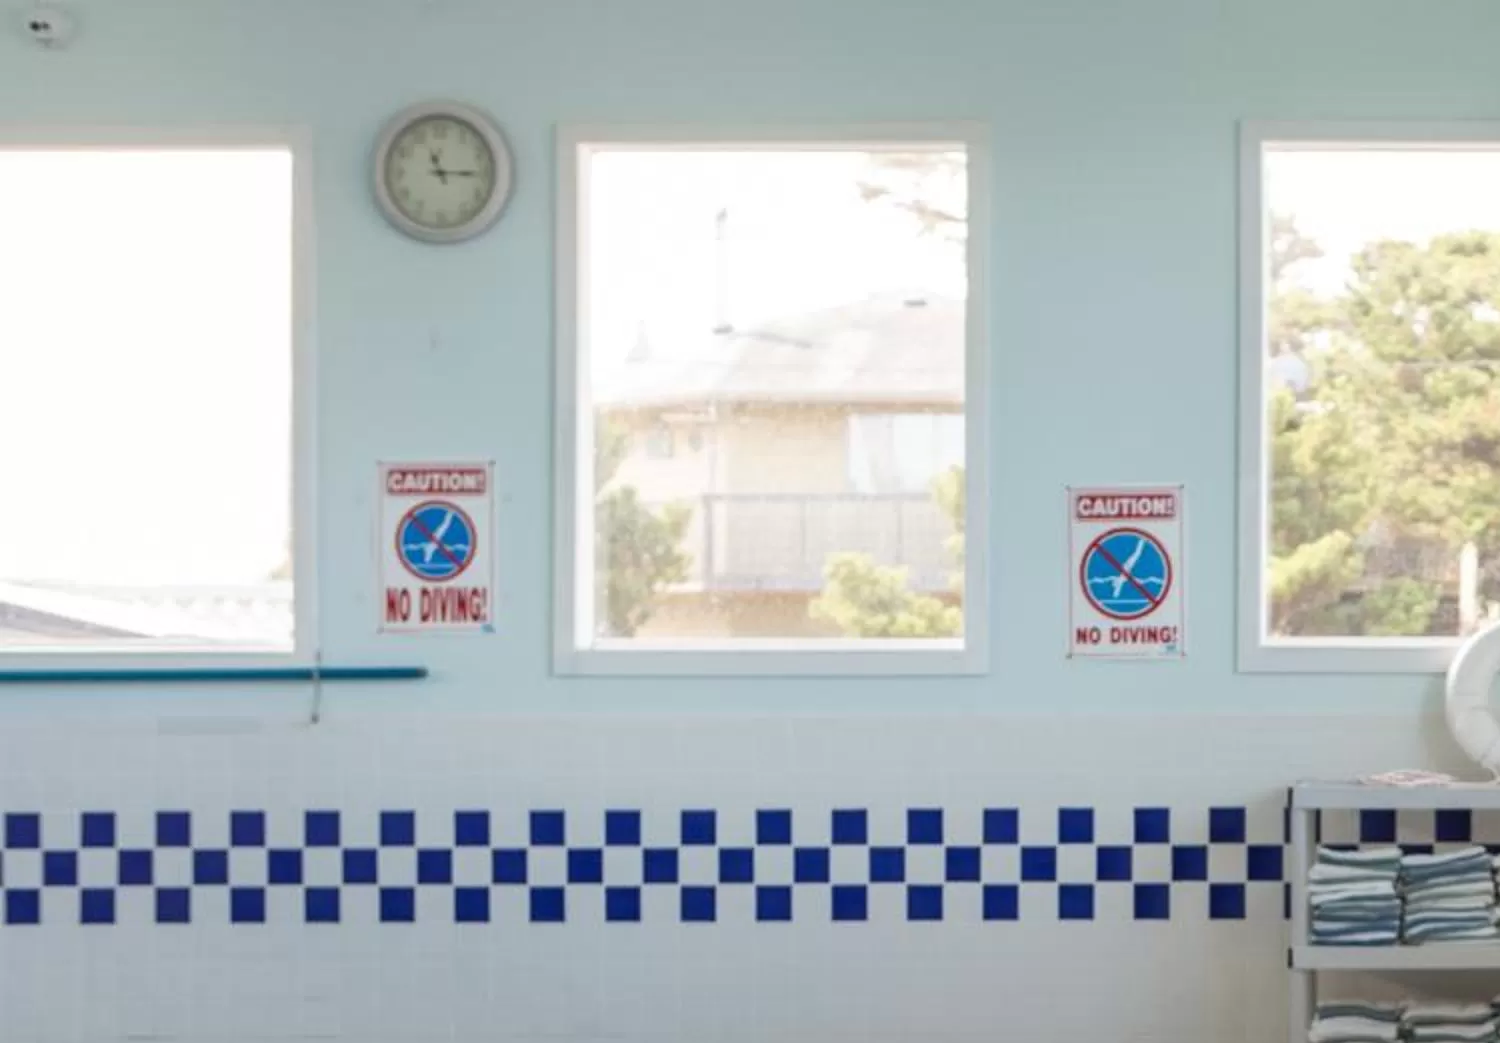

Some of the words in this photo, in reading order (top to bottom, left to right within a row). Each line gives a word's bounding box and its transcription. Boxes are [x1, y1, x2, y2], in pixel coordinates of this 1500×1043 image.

[390, 473, 485, 491] CAUTION!
[1078, 497, 1175, 516] CAUTION!
[386, 587, 411, 622] NO
[420, 587, 487, 622] DIVING!
[1076, 628, 1101, 644] NO
[1110, 626, 1177, 644] DIVING!
